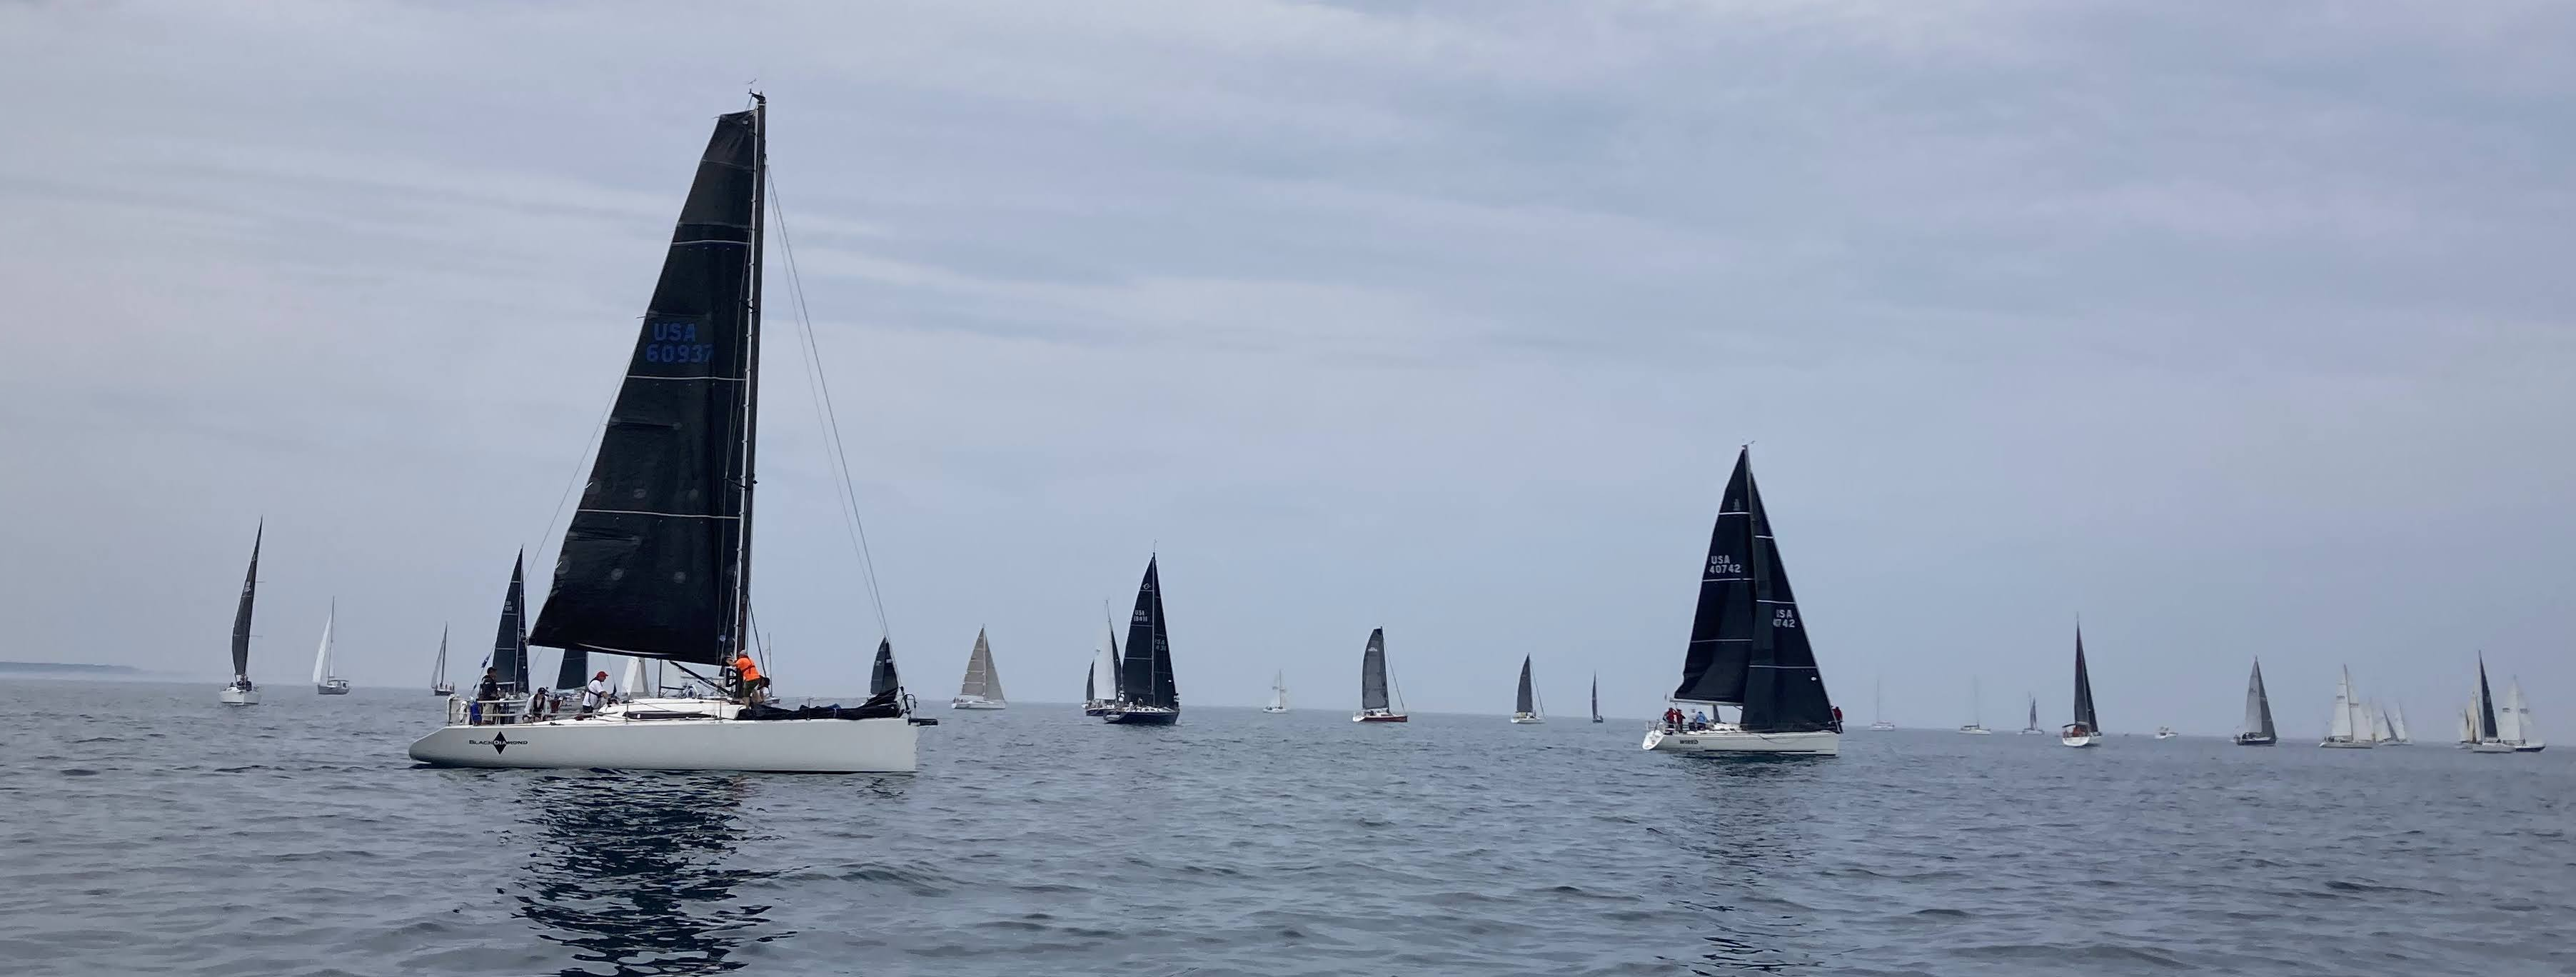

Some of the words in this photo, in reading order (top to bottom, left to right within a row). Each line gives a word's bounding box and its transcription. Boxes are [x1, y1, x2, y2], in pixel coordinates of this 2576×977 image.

[654, 324, 695, 341] USA
[646, 344, 713, 363] 60937
[1711, 555, 1730, 564] USA
[1709, 564, 1741, 573] 40742
